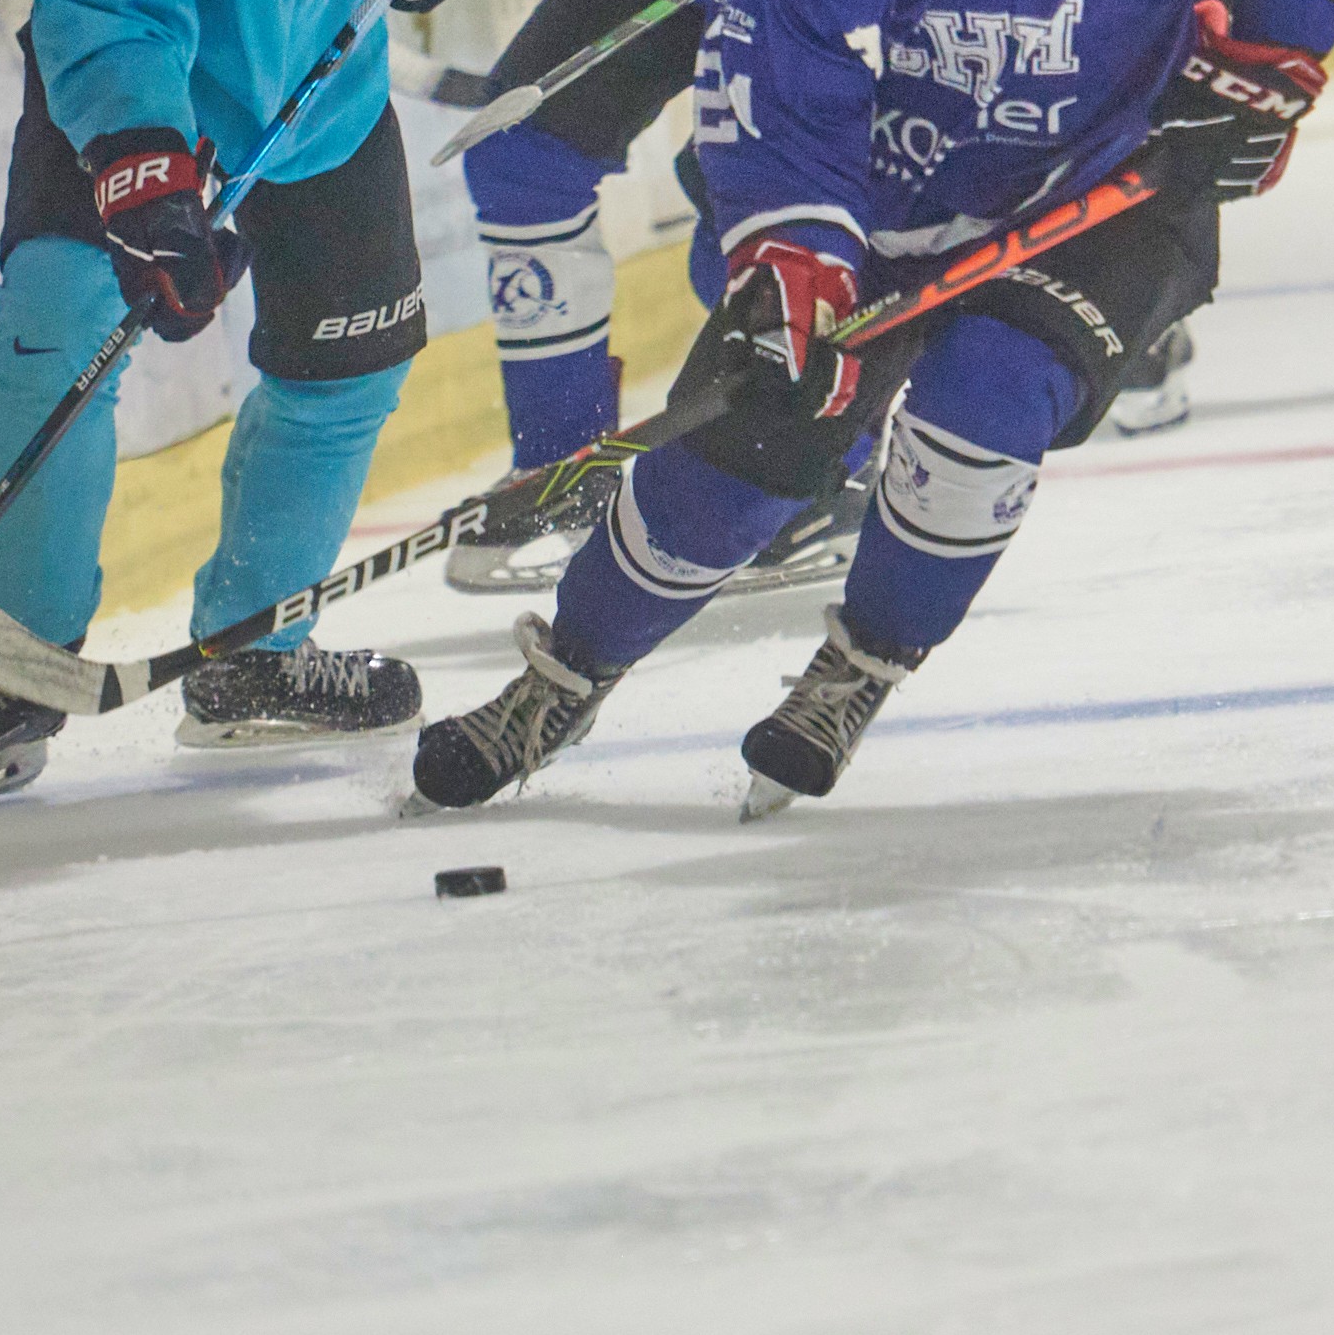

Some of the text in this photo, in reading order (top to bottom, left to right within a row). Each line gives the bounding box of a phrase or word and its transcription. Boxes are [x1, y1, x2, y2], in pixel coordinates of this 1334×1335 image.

[1182, 55, 1307, 120] CCM
[75, 326, 126, 392] BAUER
[272, 503, 489, 634] BAUER
